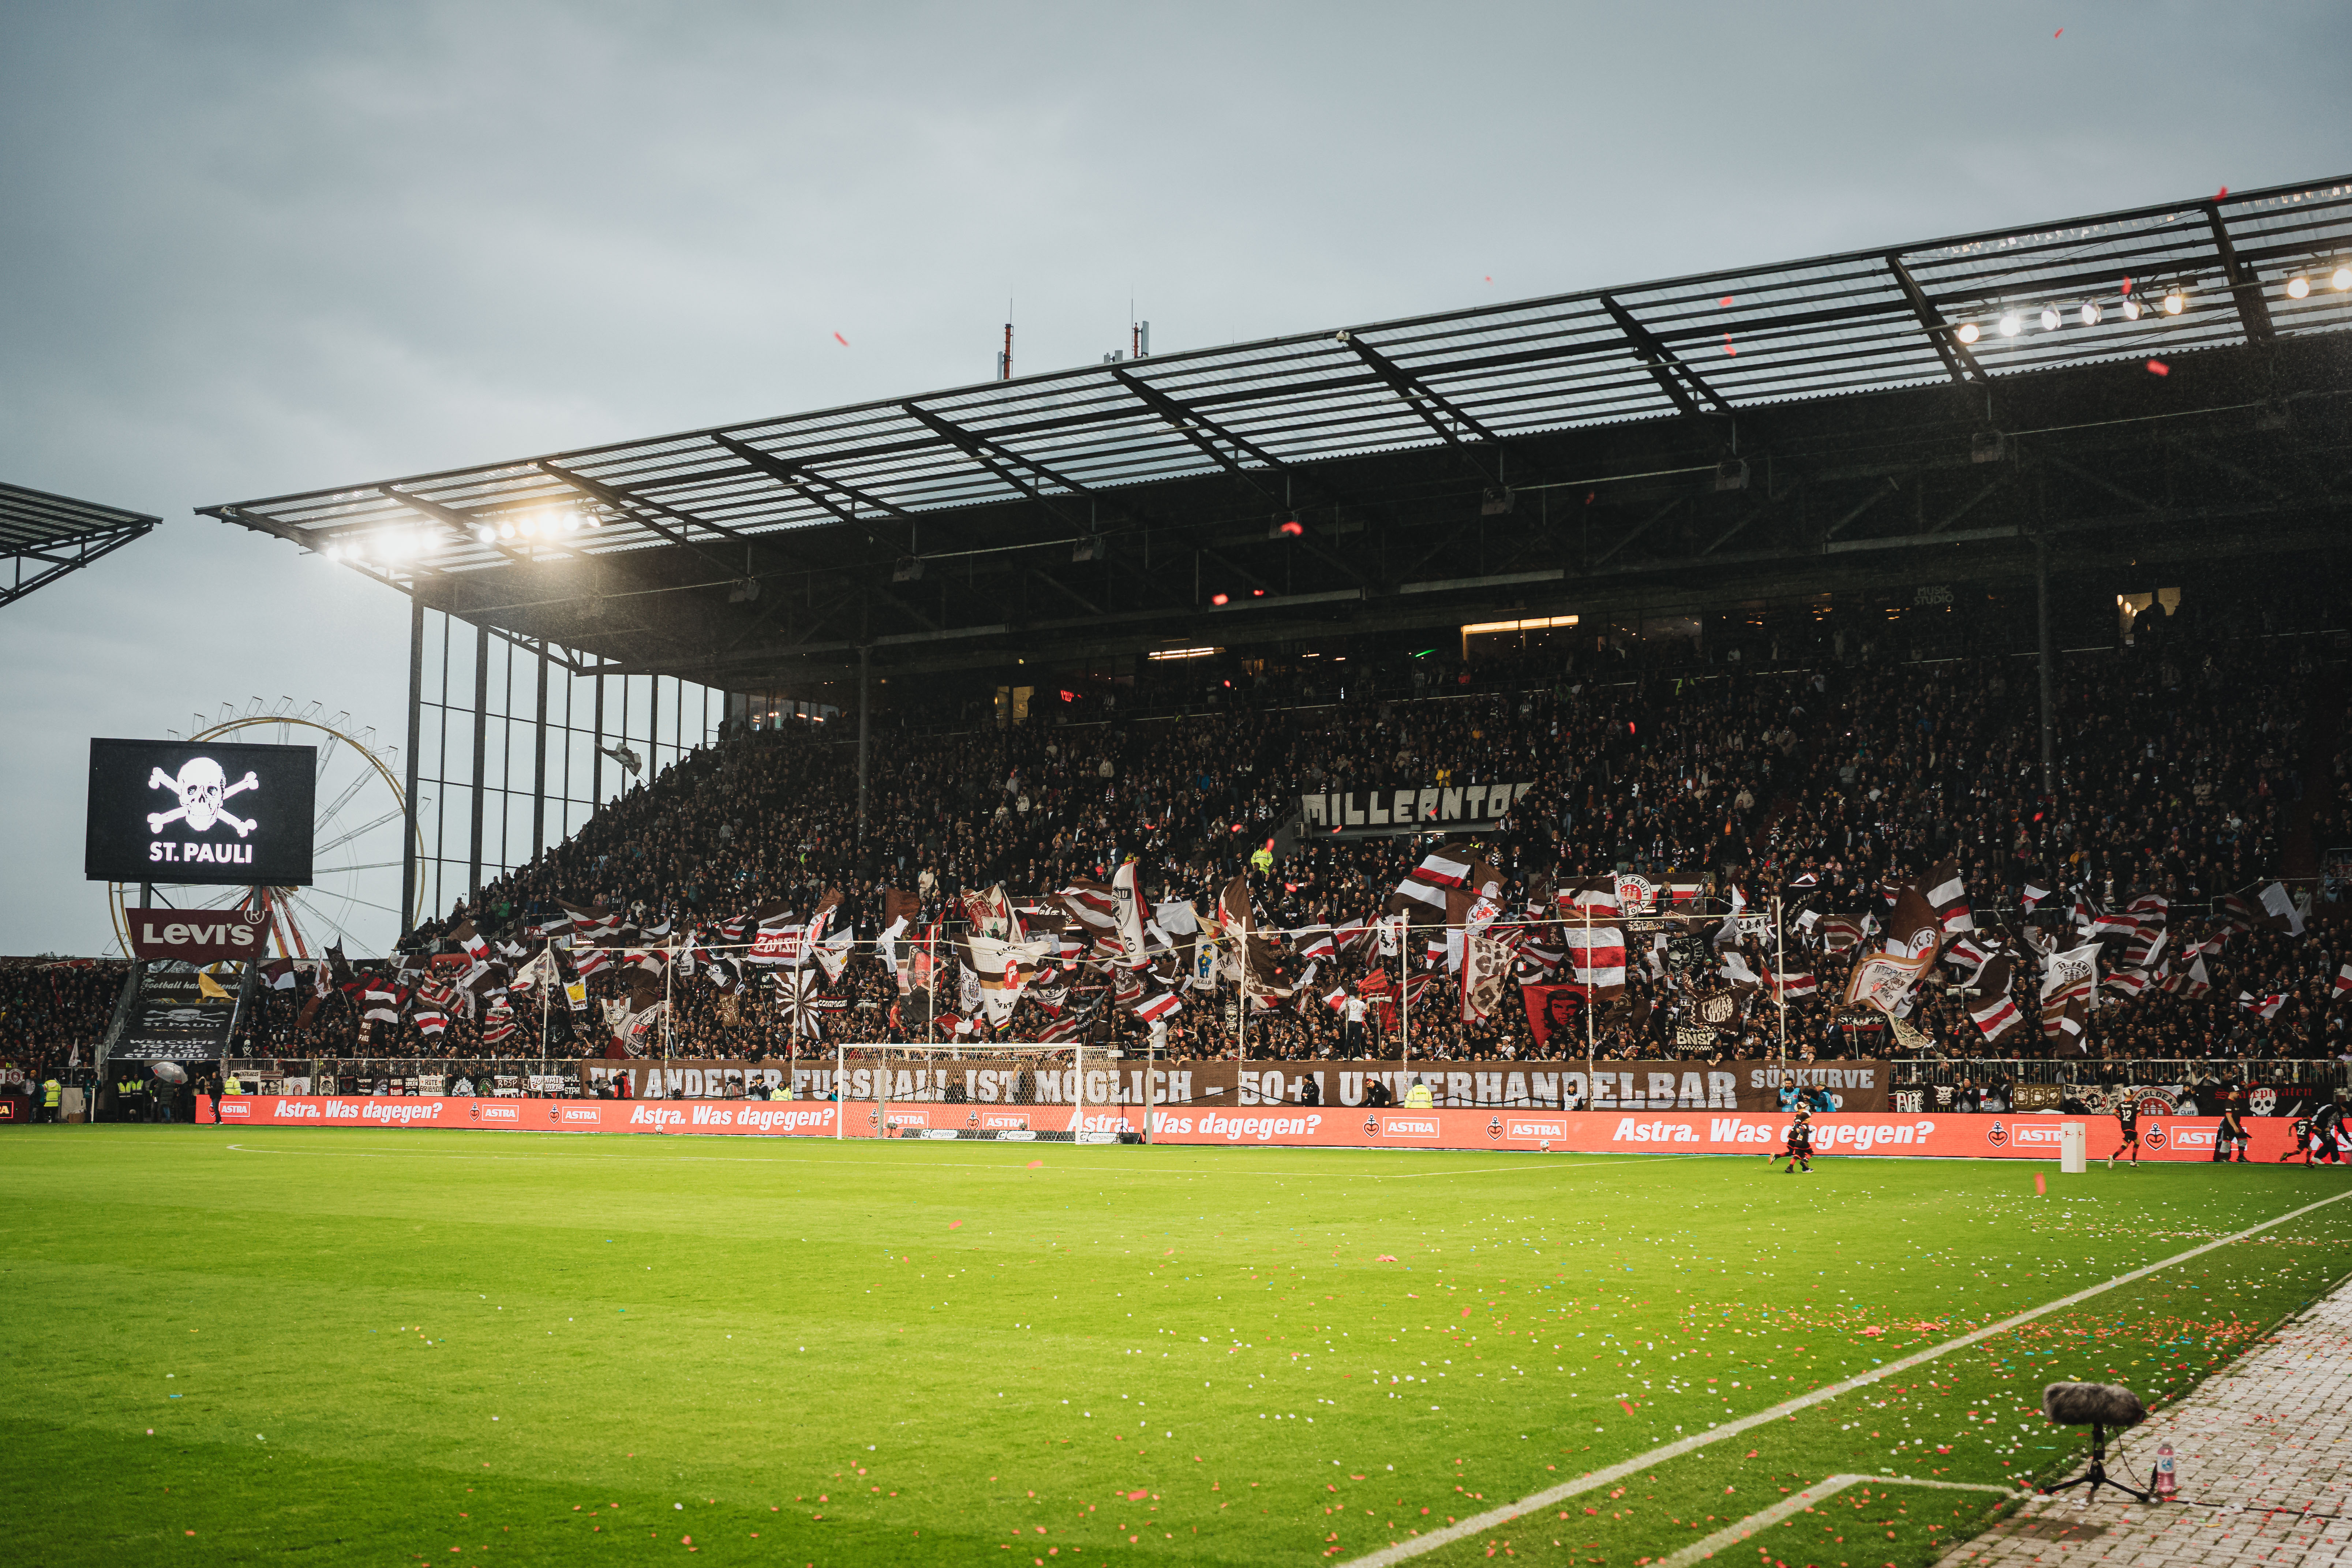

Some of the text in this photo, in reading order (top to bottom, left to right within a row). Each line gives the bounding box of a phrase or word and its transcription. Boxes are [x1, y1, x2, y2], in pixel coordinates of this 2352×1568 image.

[1917, 585, 1951, 596] MUSIC
[1914, 594, 1954, 606] STUDIO
[150, 842, 252, 863] ST. PAULI
[1631, 878, 1649, 896] PAULI
[2072, 962, 2089, 975] PAUL
[1677, 1031, 1715, 1045] BNSP
[2215, 1086, 2312, 1100] Salepiraten
[274, 1100, 443, 1123] Astra. Was dagegen?
[485, 1109, 516, 1118] ASTRA
[565, 1111, 597, 1120] ASTRA
[2122, 1110, 2131, 1121] 12
[630, 1105, 835, 1131] Astra. Was dagegen?
[887, 1115, 925, 1124] ASTRA
[986, 1118, 1026, 1127] ASTRA
[1066, 1111, 1135, 1133] Astra.
[1198, 1112, 1322, 1140] dagegen?
[1387, 1122, 1435, 1133] ASTRA
[1512, 1124, 1561, 1135] ASTRA
[1613, 1118, 1700, 1142] Astra.
[1710, 1118, 1772, 1143] Was
[2018, 1130, 2061, 1142] ASTR
